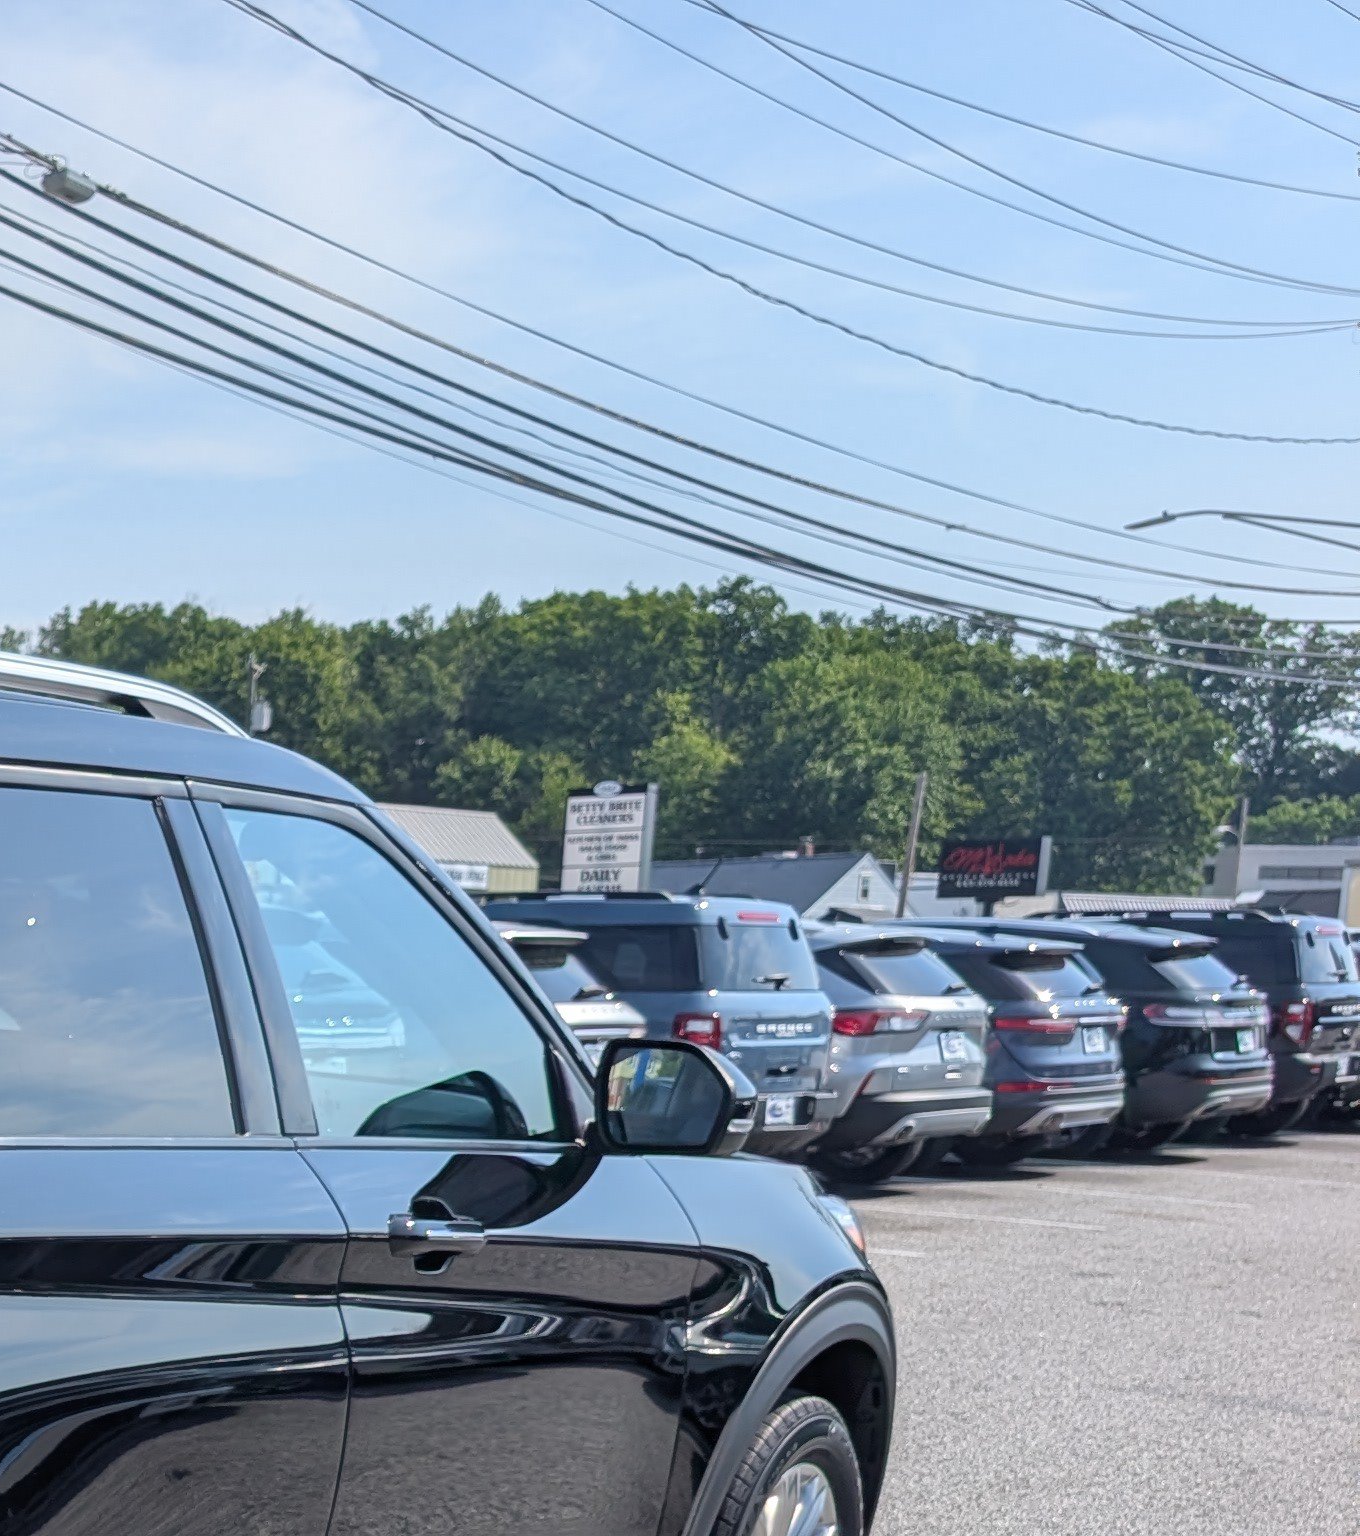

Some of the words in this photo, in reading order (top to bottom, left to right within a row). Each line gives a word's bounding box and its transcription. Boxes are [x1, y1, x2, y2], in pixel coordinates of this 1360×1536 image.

[609, 799, 642, 811] BRITE
[576, 813, 634, 825] CLEANERS
[580, 868, 621, 882] DAILY
